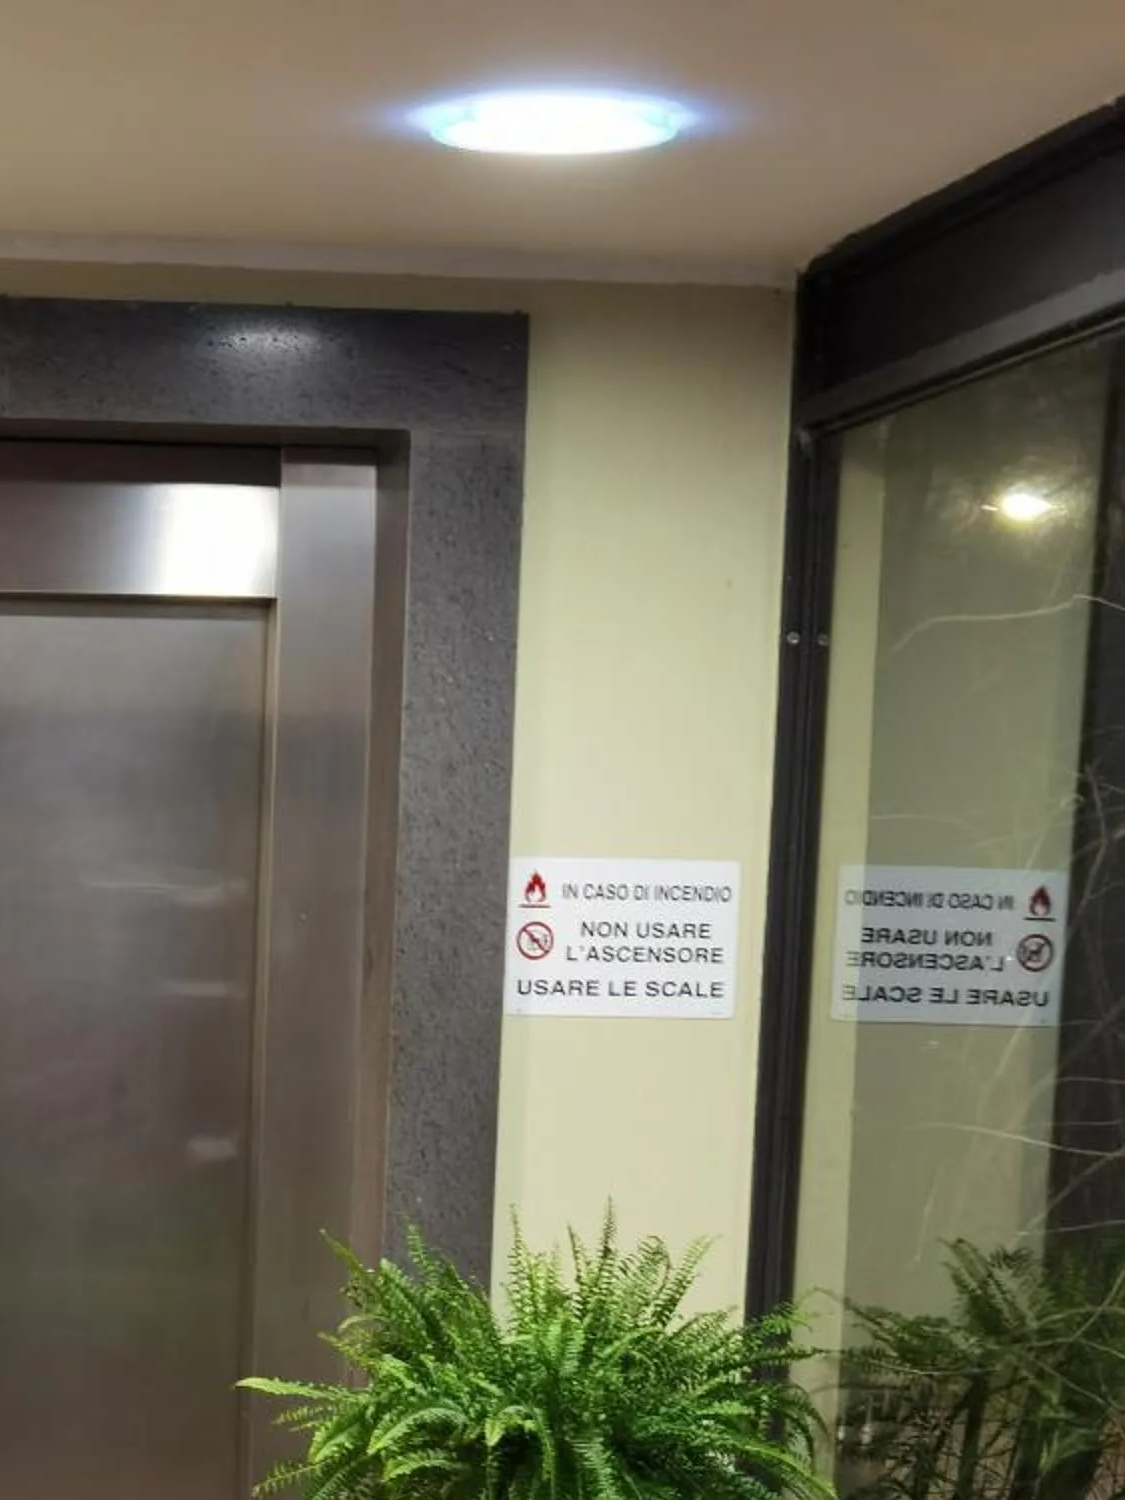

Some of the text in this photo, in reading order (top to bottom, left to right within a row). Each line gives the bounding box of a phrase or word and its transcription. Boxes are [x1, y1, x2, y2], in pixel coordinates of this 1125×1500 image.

[562, 883, 732, 903] IN CASO DI INCENDIO
[580, 921, 712, 940] NON USARE
[566, 946, 724, 964] L'ASCENSORE
[517, 979, 724, 998] USARE LE SCALE
